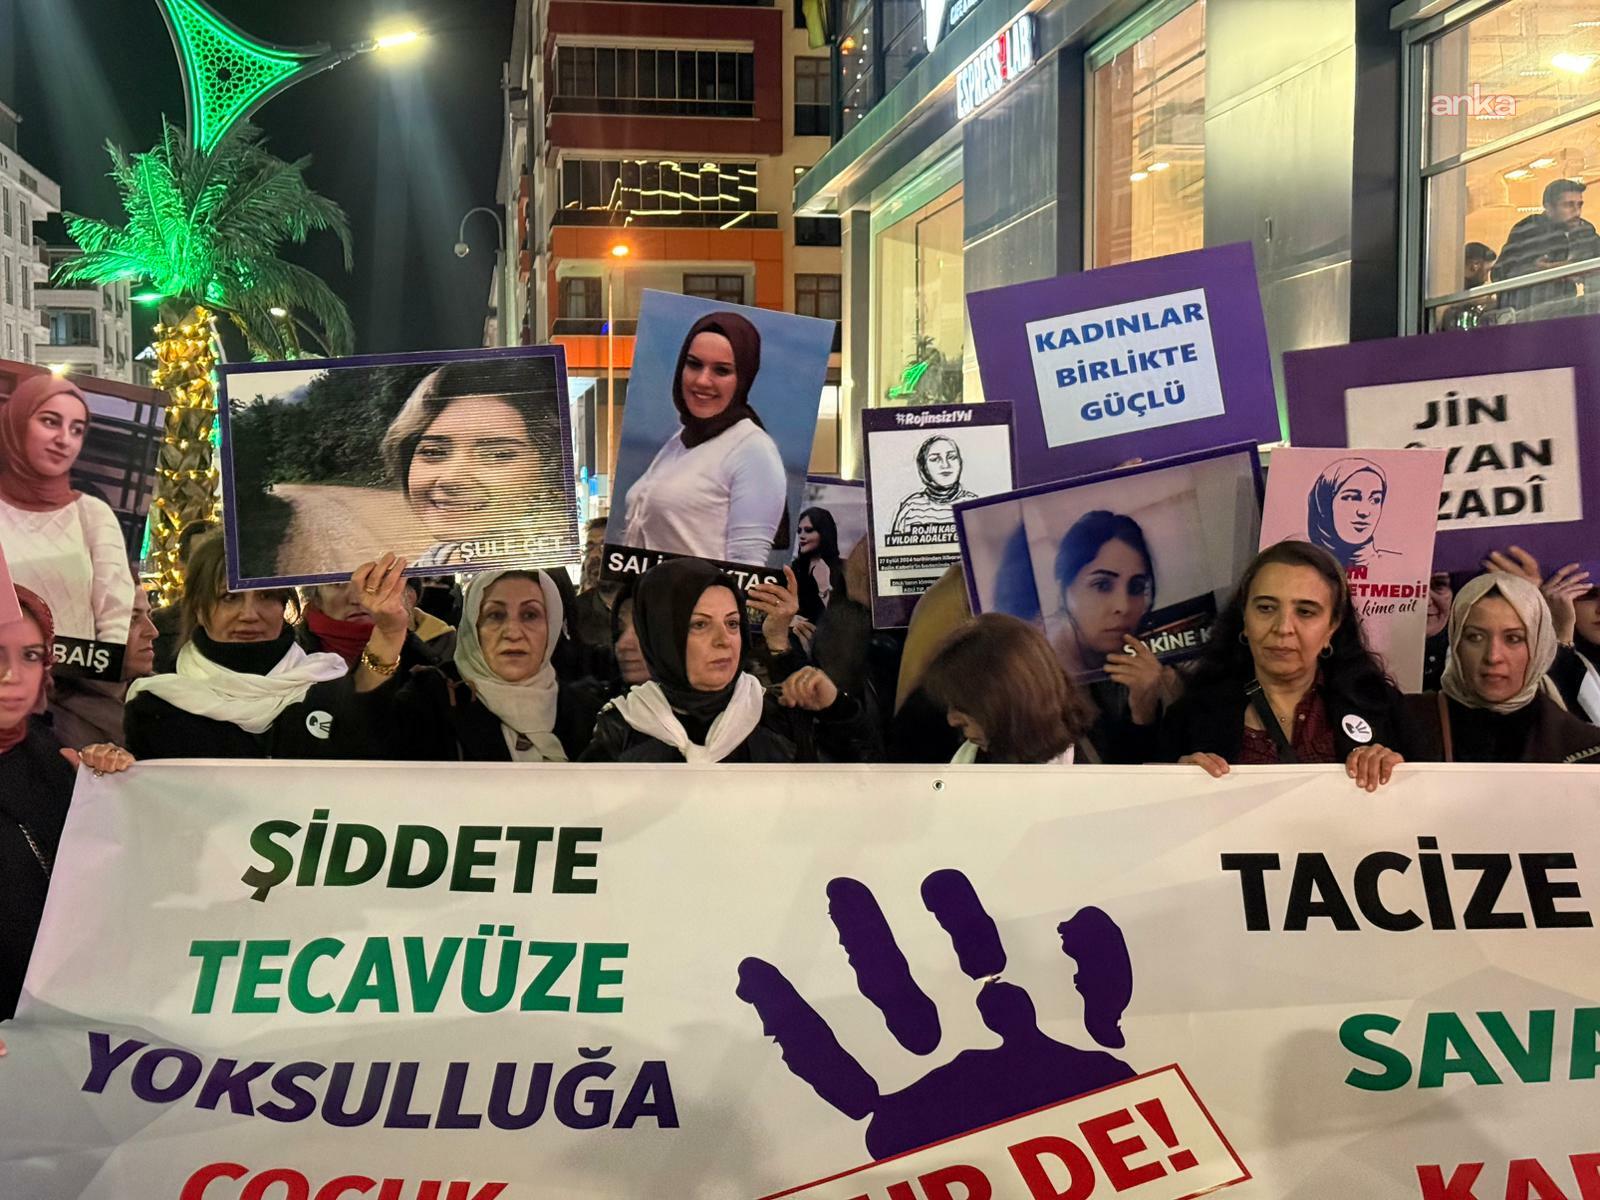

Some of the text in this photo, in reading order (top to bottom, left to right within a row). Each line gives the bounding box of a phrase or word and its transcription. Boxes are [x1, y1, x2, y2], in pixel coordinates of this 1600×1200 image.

[1035, 303, 1204, 353] KADINLAR
[1056, 343, 1198, 388] BİRLİKTE
[1080, 380, 1186, 421] GÜÇLÜ
[1414, 391, 1508, 430] JİN
[891, 535, 919, 545] YILDIR
[920, 532, 953, 543] ADALET
[1362, 600, 1394, 617] kime
[241, 808, 603, 902] ŞİDDETE
[1221, 836, 1593, 932] TACİZE
[189, 925, 629, 1014] TECAVÜZE
[80, 1031, 680, 1130] YOKSULLUĞA
[1007, 1097, 1200, 1200] DE!
